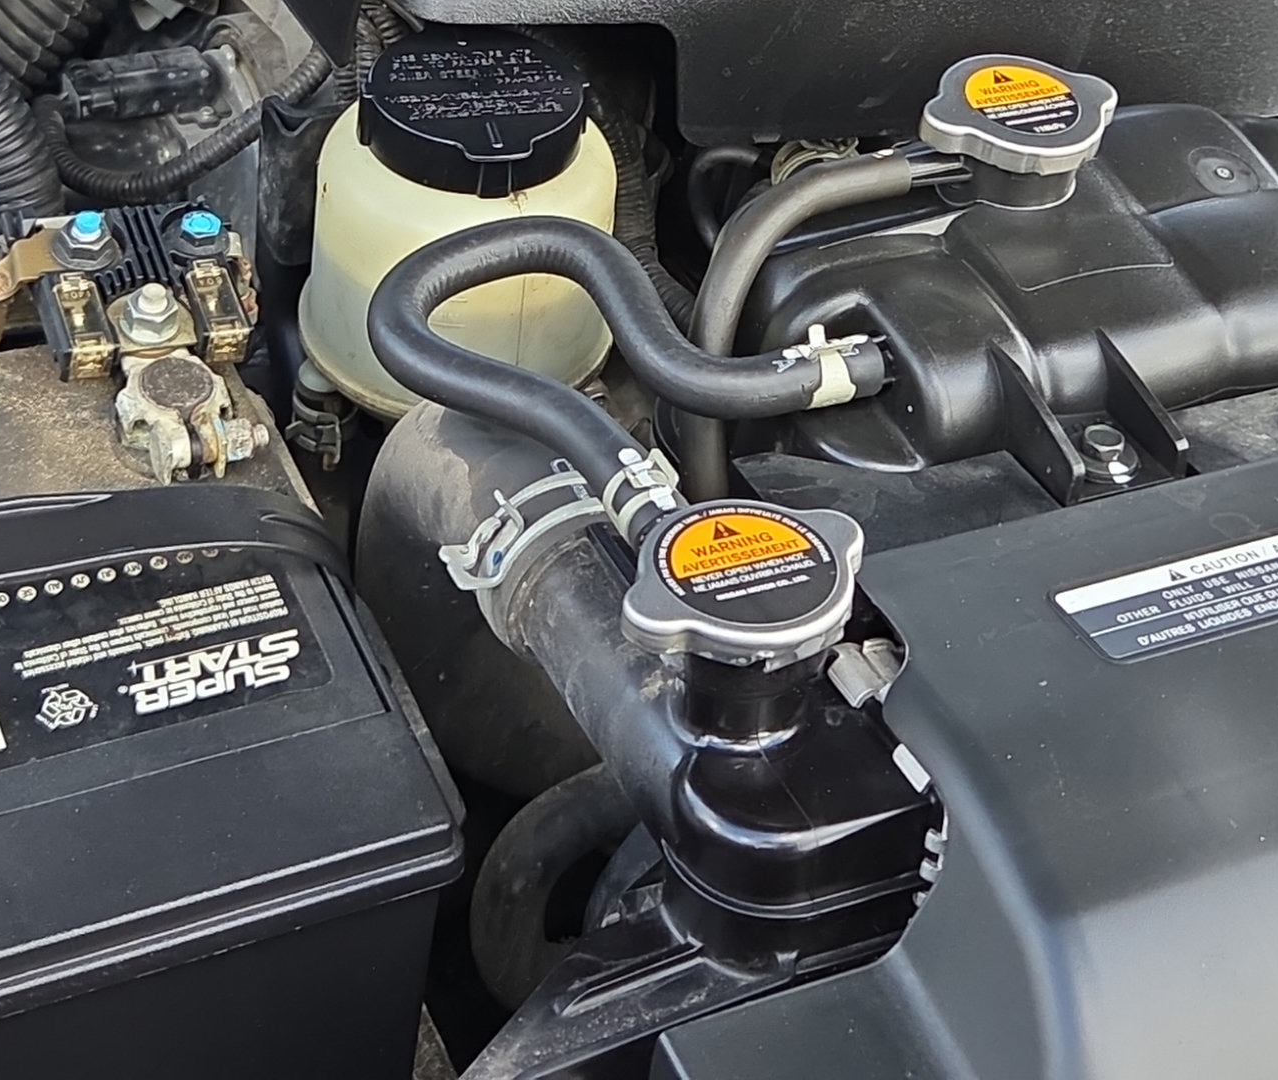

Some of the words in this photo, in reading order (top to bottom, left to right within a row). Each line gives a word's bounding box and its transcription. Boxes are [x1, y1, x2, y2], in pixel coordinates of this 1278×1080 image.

[974, 85, 1059, 106] AVERTISSEMENT
[978, 78, 1039, 96] WARNING
[681, 536, 799, 576] AVERTISSEMENT
[690, 528, 774, 560] WARNING
[689, 570, 724, 585] NEVER
[723, 563, 752, 577] OPEN
[751, 556, 784, 571] WHEN
[1189, 546, 1258, 577] CAUTION
[1115, 603, 1161, 624] OTHER
[1167, 589, 1215, 610] FLUIDS
[1221, 578, 1254, 595] WILL
[1161, 582, 1195, 601] ONLY
[1201, 573, 1230, 590] USE
[1240, 592, 1265, 606] QUE
[1136, 621, 1196, 647] D'AUTRES
[1197, 606, 1252, 630] LIQUIDES
[122, 627, 303, 699] START
[131, 654, 292, 717] SUPER
